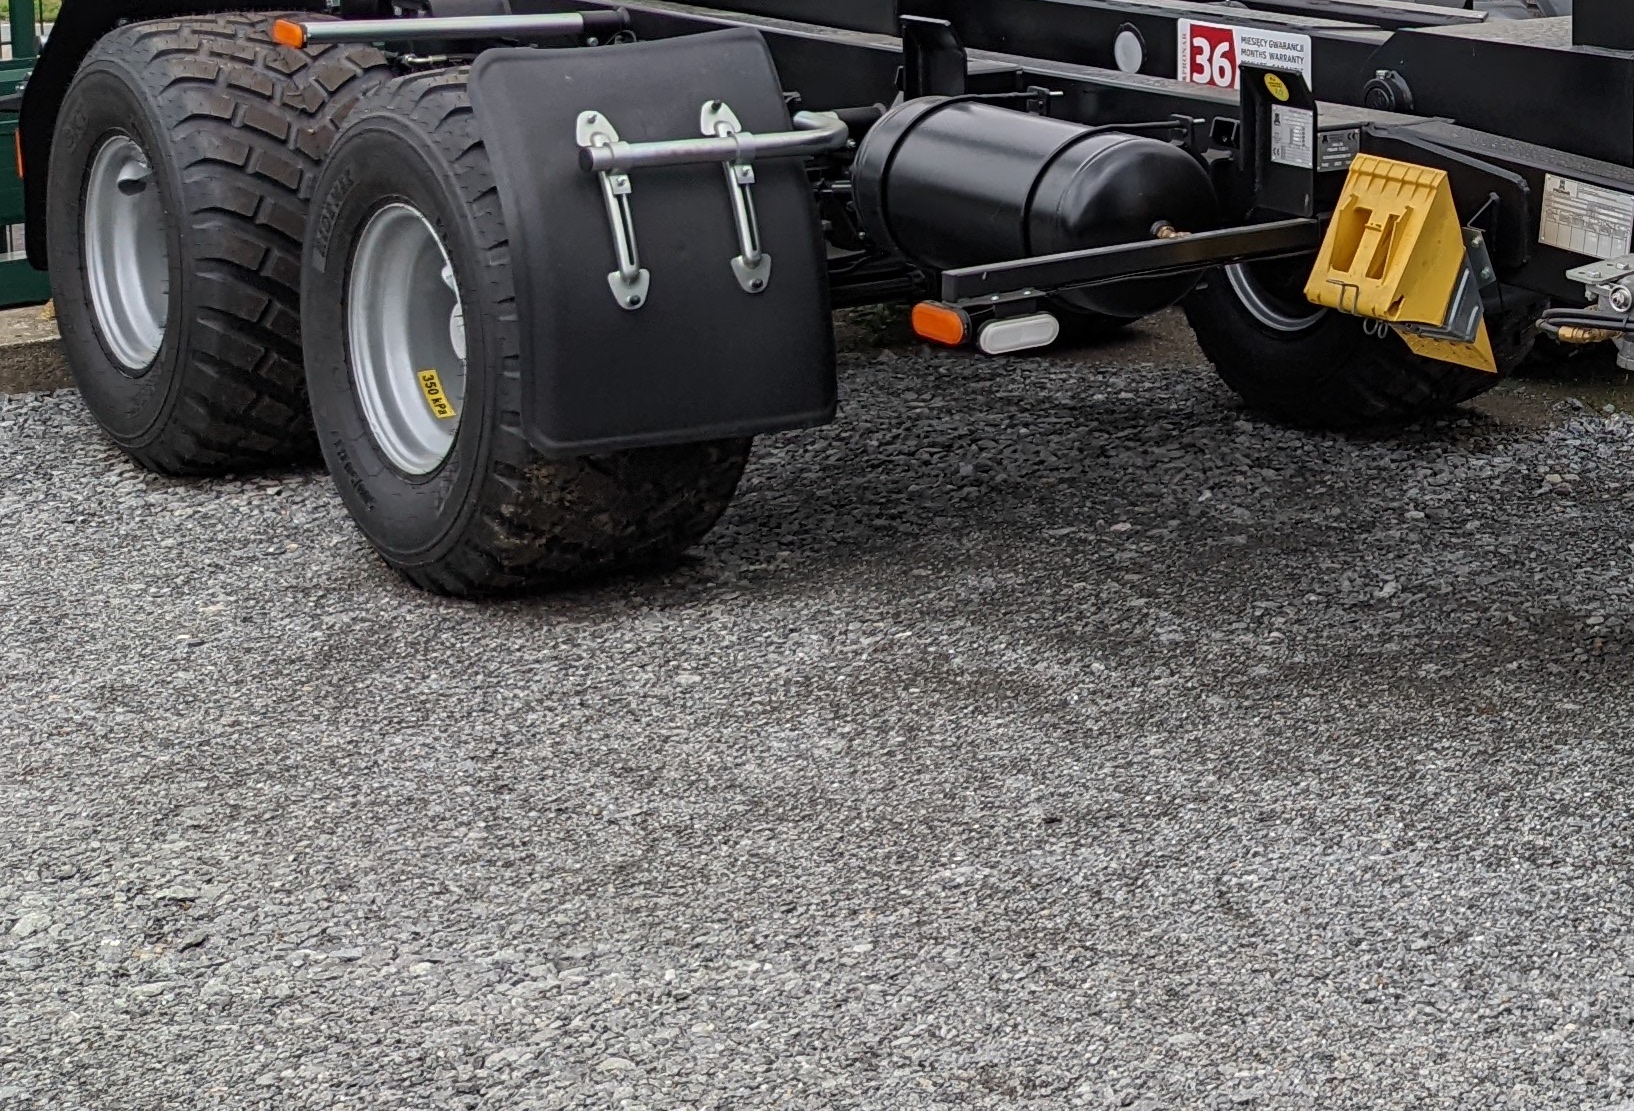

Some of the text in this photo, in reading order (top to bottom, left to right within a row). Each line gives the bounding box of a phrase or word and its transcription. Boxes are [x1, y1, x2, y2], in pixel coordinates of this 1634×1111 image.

[1192, 36, 1232, 87] 36
[1241, 48, 1267, 59] MONTHS
[1269, 52, 1305, 64] WARRANTY
[422, 374, 448, 415] 350 kPa
